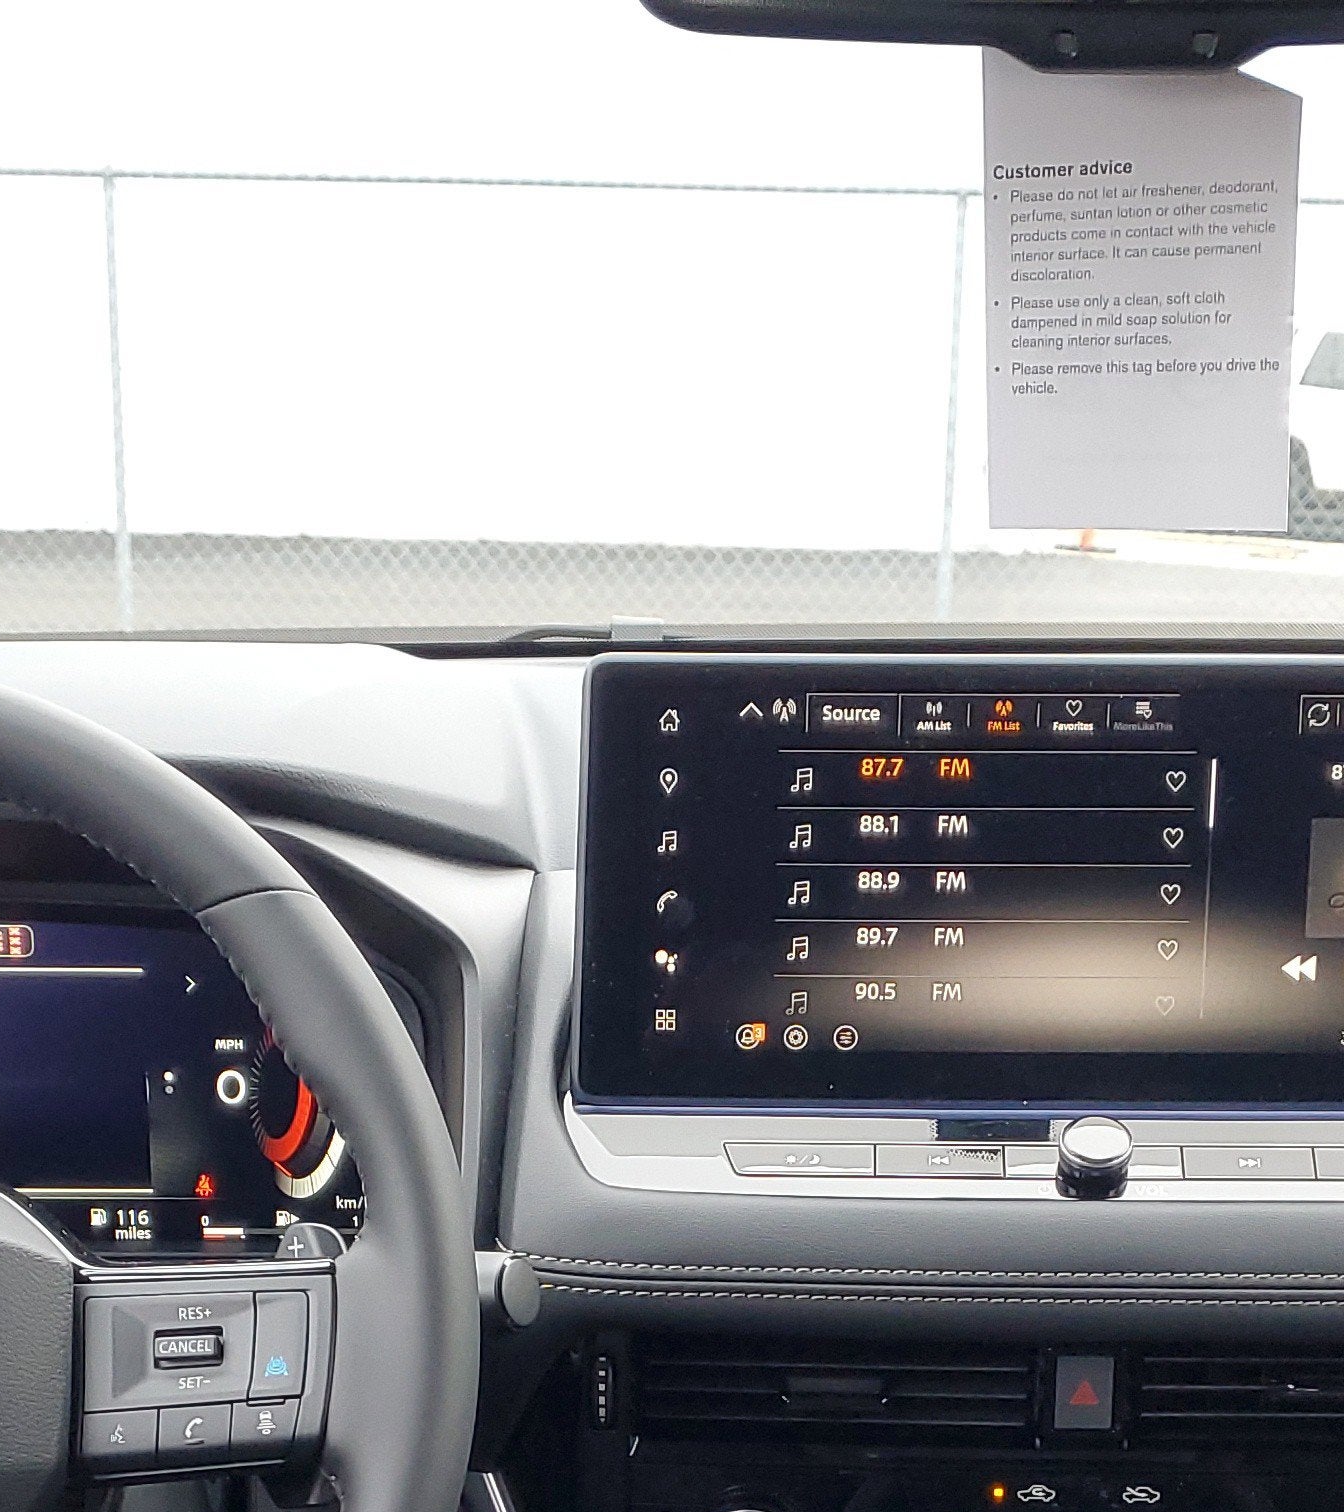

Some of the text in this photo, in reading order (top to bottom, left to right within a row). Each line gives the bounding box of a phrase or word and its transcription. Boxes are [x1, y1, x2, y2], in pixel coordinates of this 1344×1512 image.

[993, 161, 1133, 180] Customer advice
[1011, 180, 1278, 203] Please do not let air freshener, deodorant,
[1011, 202, 1268, 224] perfume, suntan lotion or other cosmetic
[1011, 221, 1276, 246] products come in contact with the vehicle
[1011, 269, 1094, 282] discoloration.
[1012, 291, 1225, 310] Please use only a clean, soft cloth
[1011, 311, 1231, 330] dampened in mild soap solution for
[1012, 333, 1172, 350] cleaning interior surfaces.
[1012, 358, 1280, 376] Please remove this tag before you drive the
[1012, 382, 1058, 395] vehicle.
[822, 705, 881, 721] Source
[916, 721, 951, 731] AM List
[987, 721, 1020, 731] FM List
[1052, 721, 1094, 731] Favorites
[861, 759, 970, 777] 87.7 FM
[859, 816, 968, 834] 88.1 FM
[858, 871, 967, 891] 88.9 FM
[856, 928, 964, 945] 89.7 FM
[855, 983, 962, 1001] 90.5 FM
[215, 1040, 243, 1050] MPH
[116, 1210, 149, 1226] 116
[115, 1228, 151, 1240] miles
[159, 1341, 211, 1354] CANCEL
